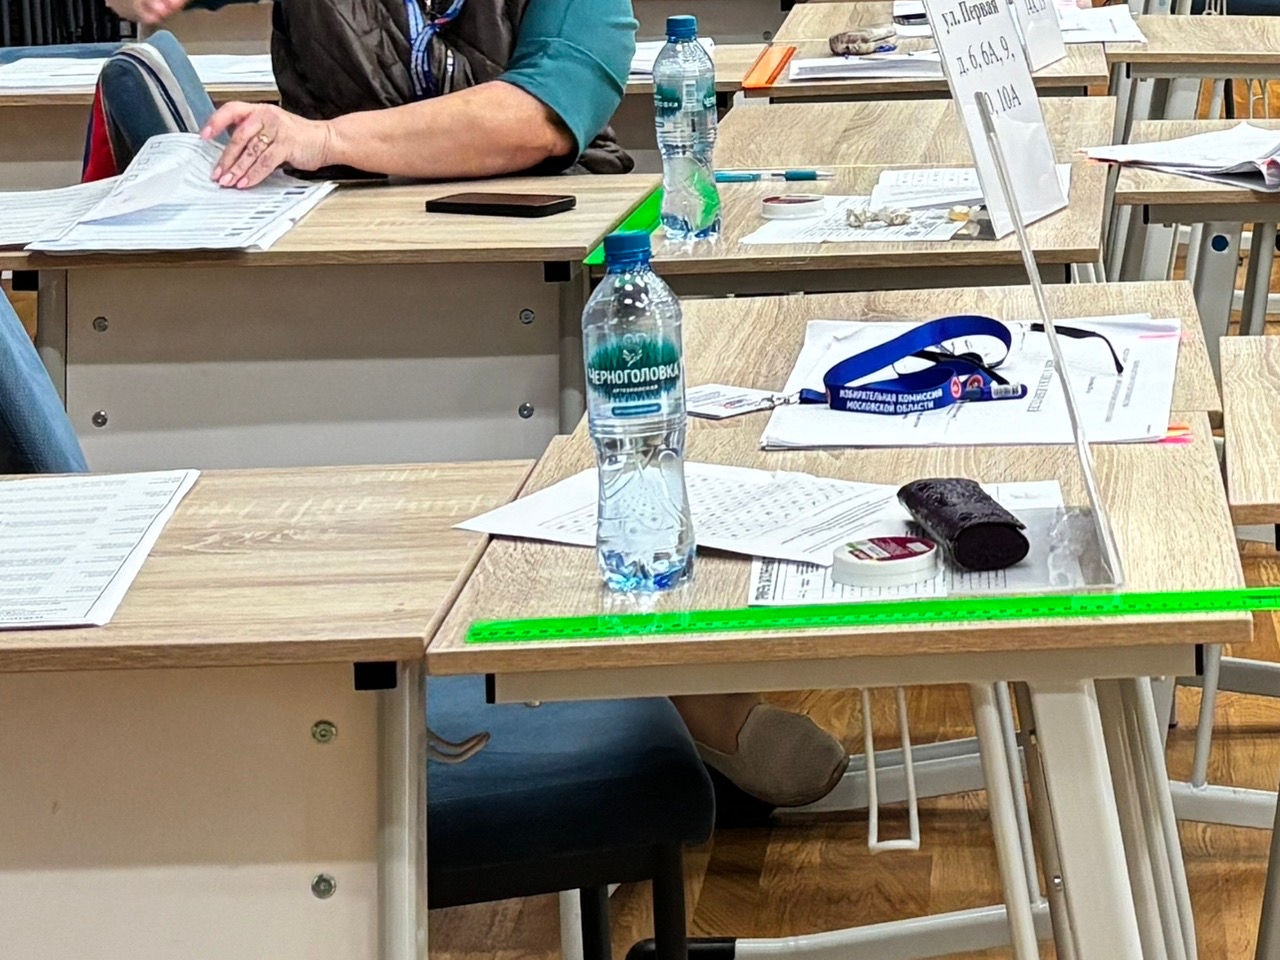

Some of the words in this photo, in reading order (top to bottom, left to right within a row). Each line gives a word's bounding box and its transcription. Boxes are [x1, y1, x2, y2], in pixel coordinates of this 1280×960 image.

[942, 10, 960, 34] ул.
[958, 0, 999, 25] Первая
[956, 57, 969, 75] д.
[968, 44, 983, 73] 6,
[980, 41, 1004, 66] 6А,
[1000, 35, 1015, 62] 9,
[997, 84, 1022, 112] 10А
[588, 362, 680, 385] ЧЕРНОГОЛОВКА
[846, 399, 895, 413] МОСКОВСКОЙ
[896, 400, 935, 413] ОБЛАСТИ
